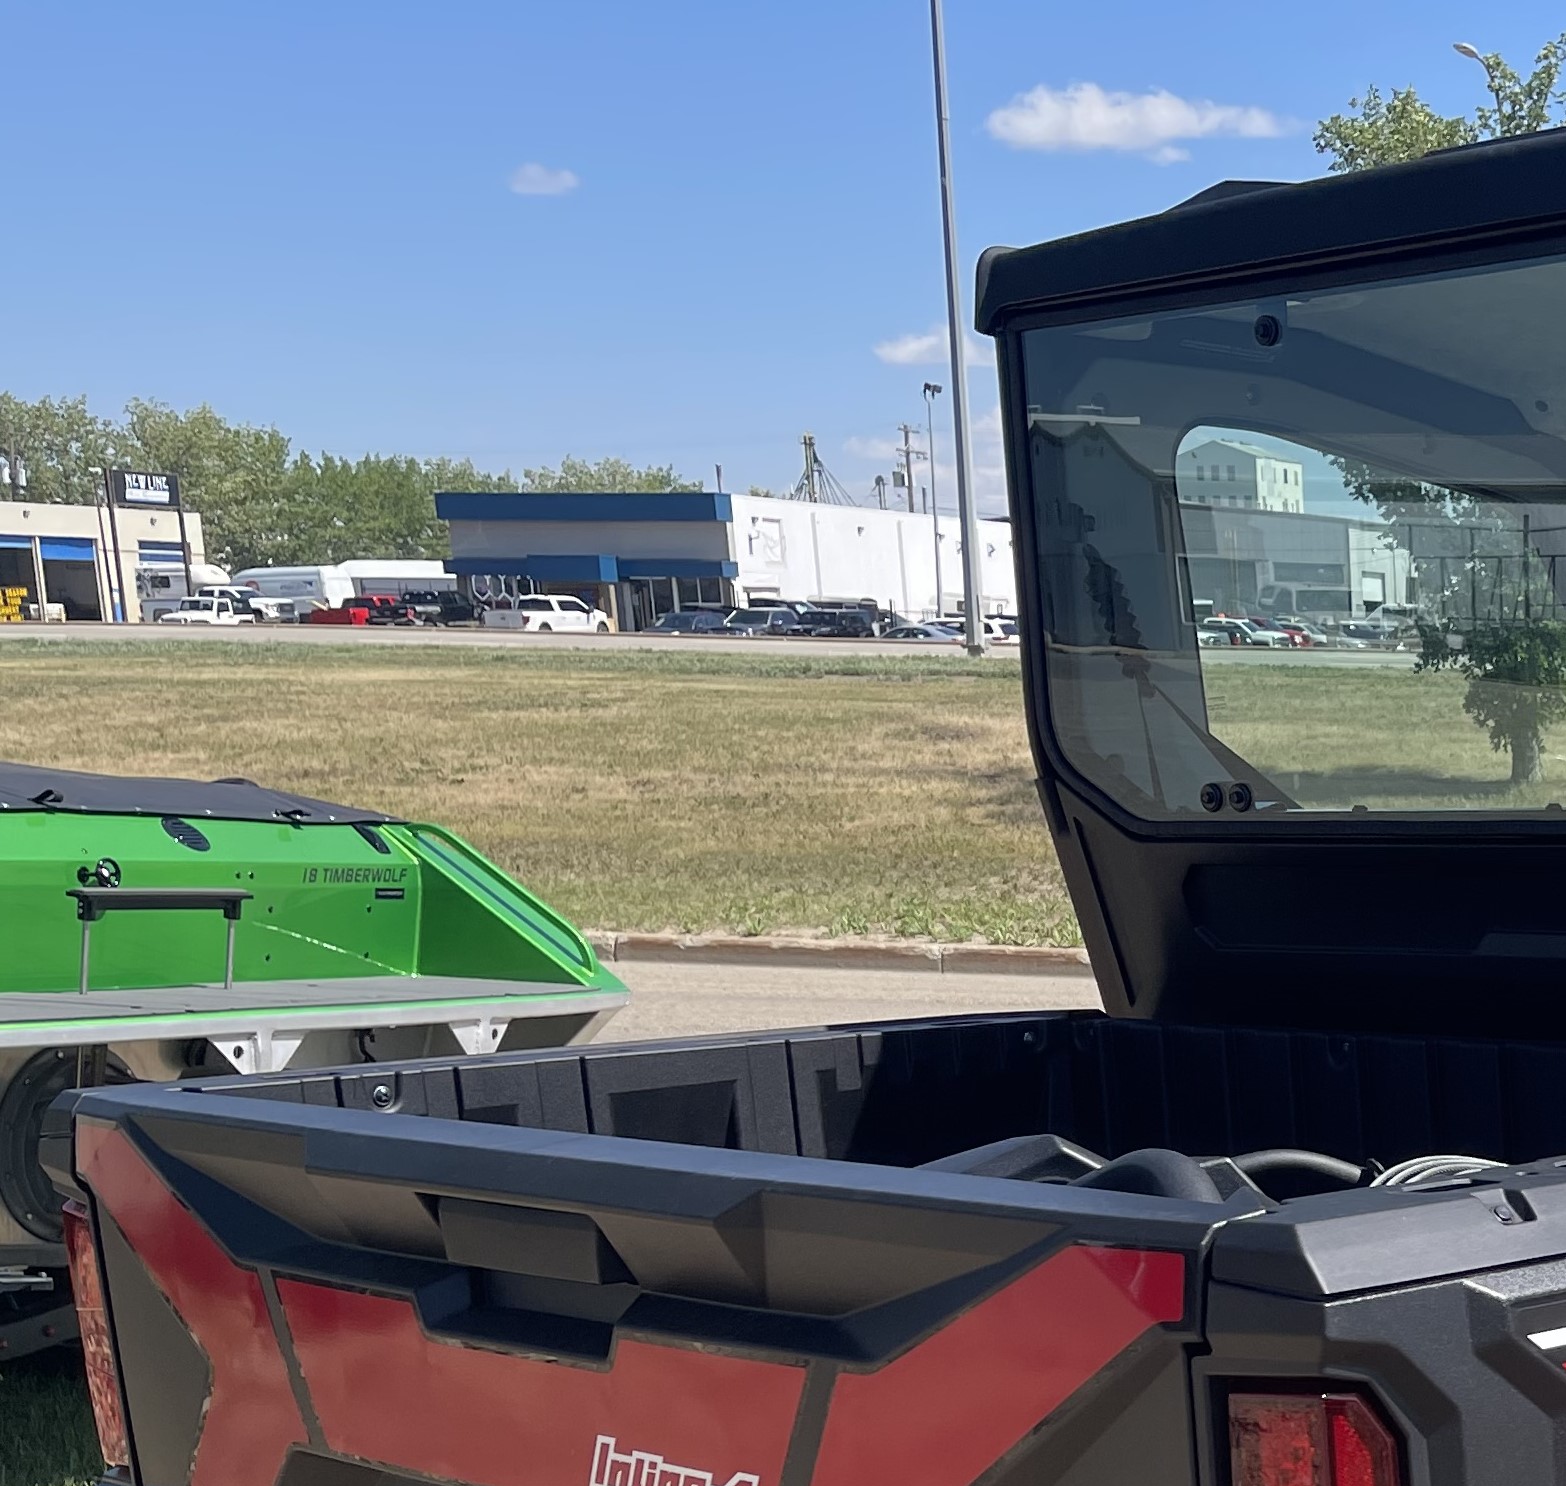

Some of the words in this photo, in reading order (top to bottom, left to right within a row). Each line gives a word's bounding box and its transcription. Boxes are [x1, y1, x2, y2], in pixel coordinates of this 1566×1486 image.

[125, 474, 146, 490] NEW
[147, 475, 169, 491] LINE
[302, 867, 318, 883] 18
[322, 867, 408, 883] TIMBERWOLF
